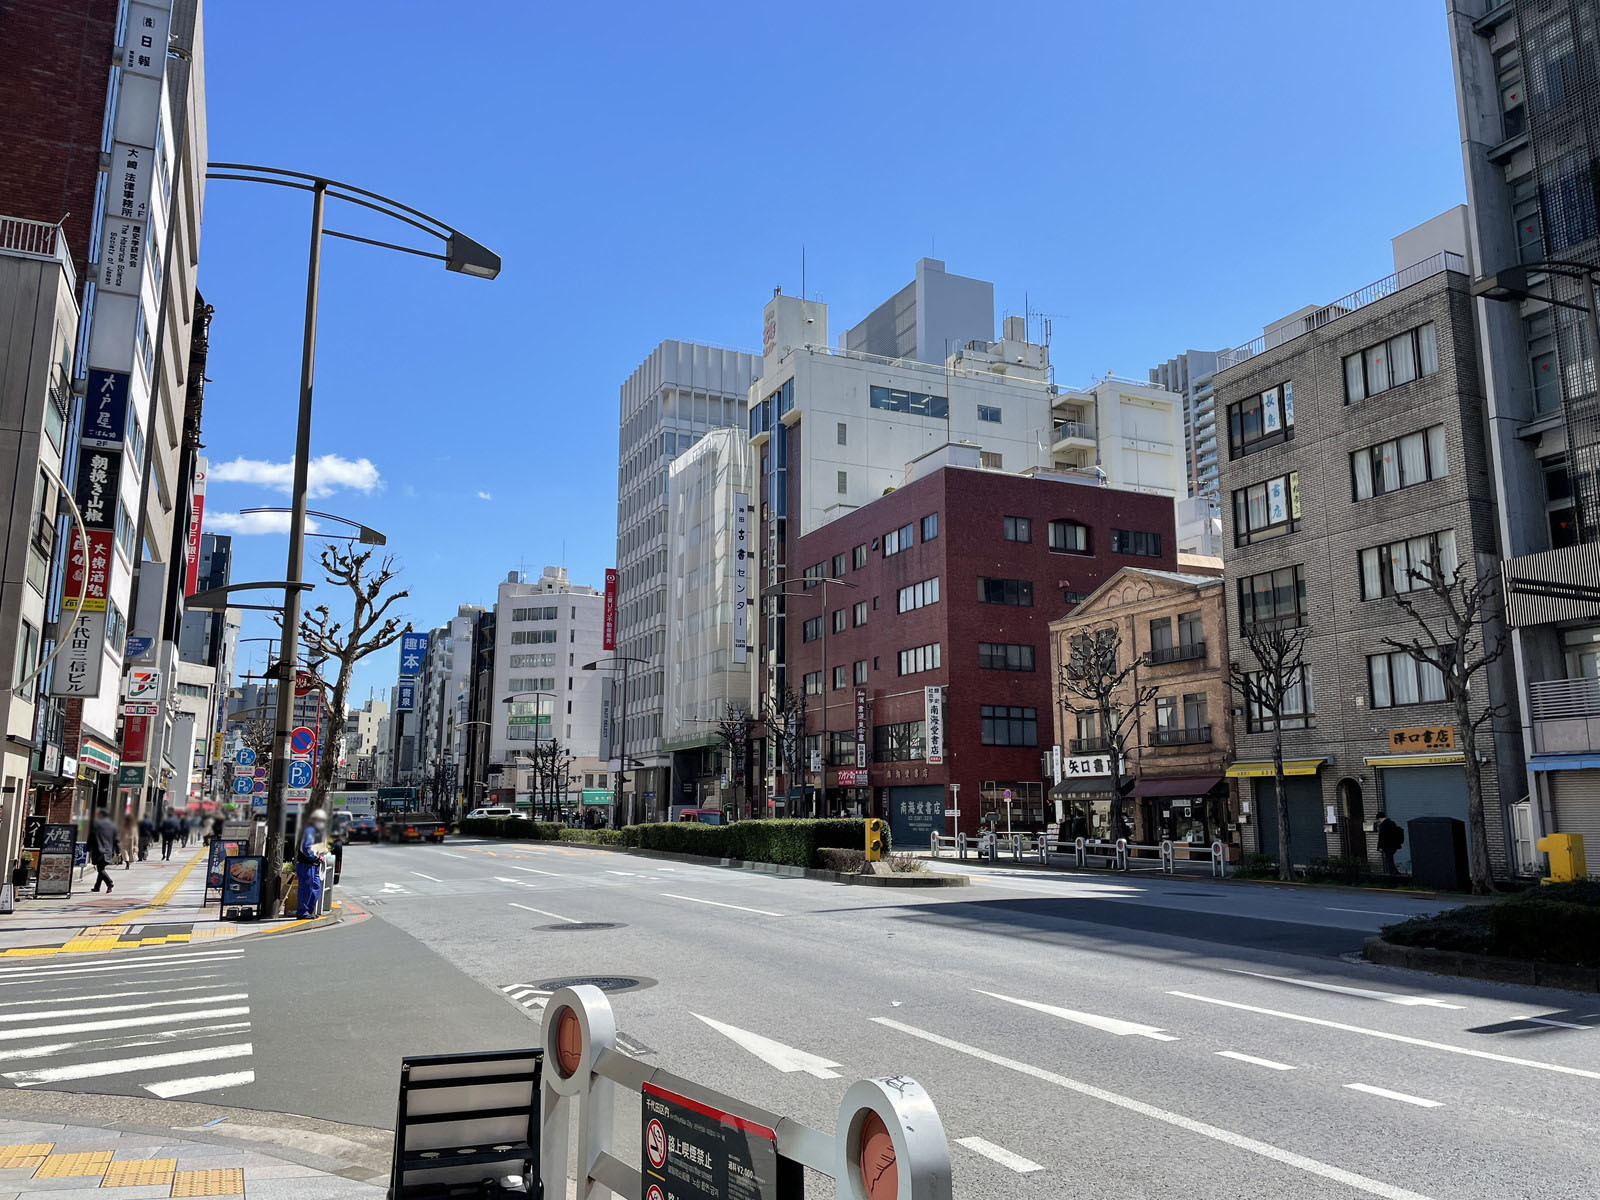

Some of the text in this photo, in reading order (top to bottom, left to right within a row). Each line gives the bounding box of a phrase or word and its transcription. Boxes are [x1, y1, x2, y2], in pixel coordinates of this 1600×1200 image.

[96, 374, 116, 429] 大戸屋
[66, 615, 92, 692] 千代田三信ビル
[403, 653, 419, 669] 本
[401, 688, 412, 706] 書泉
[930, 705, 940, 755] 南海堂書店
[291, 767, 303, 784] P
[298, 777, 306, 785] 20
[900, 801, 941, 815] 南海堂書店
[44, 828, 71, 844] 大戸屋
[646, 1099, 670, 1118] 千代田区内
[668, 1134, 713, 1170] 路上喫煙禁止
